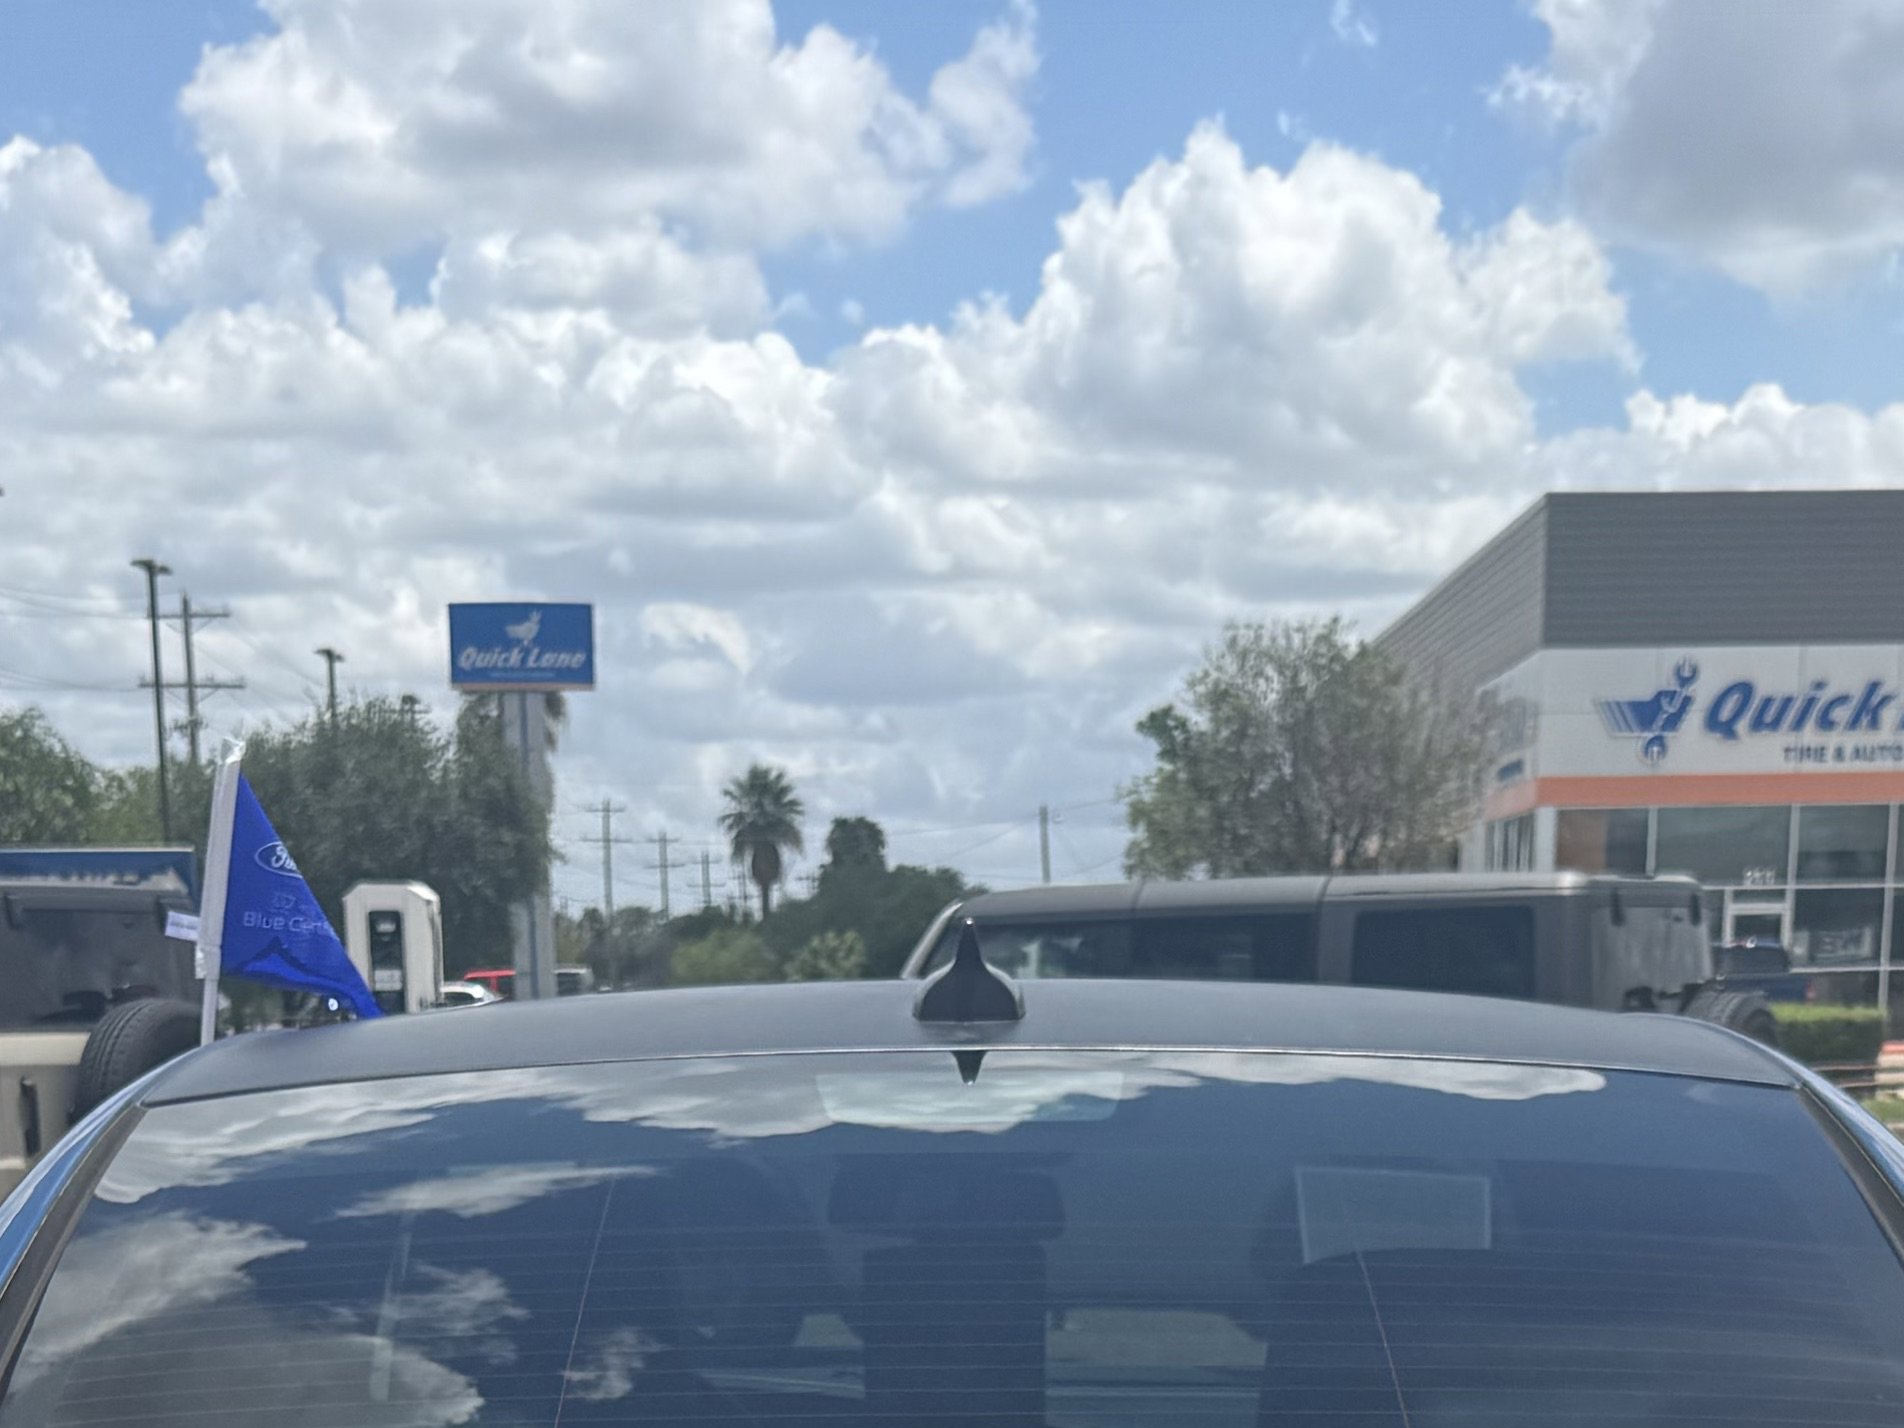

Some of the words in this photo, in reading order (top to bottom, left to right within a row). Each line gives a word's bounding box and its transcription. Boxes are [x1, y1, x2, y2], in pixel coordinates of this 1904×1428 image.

[457, 645, 522, 671] Quick
[525, 647, 587, 669] Lane
[1702, 676, 1897, 742] Quick
[1782, 745, 1827, 764] TIRE
[1849, 744, 1904, 763] AUTO
[243, 911, 286, 931] Blue
